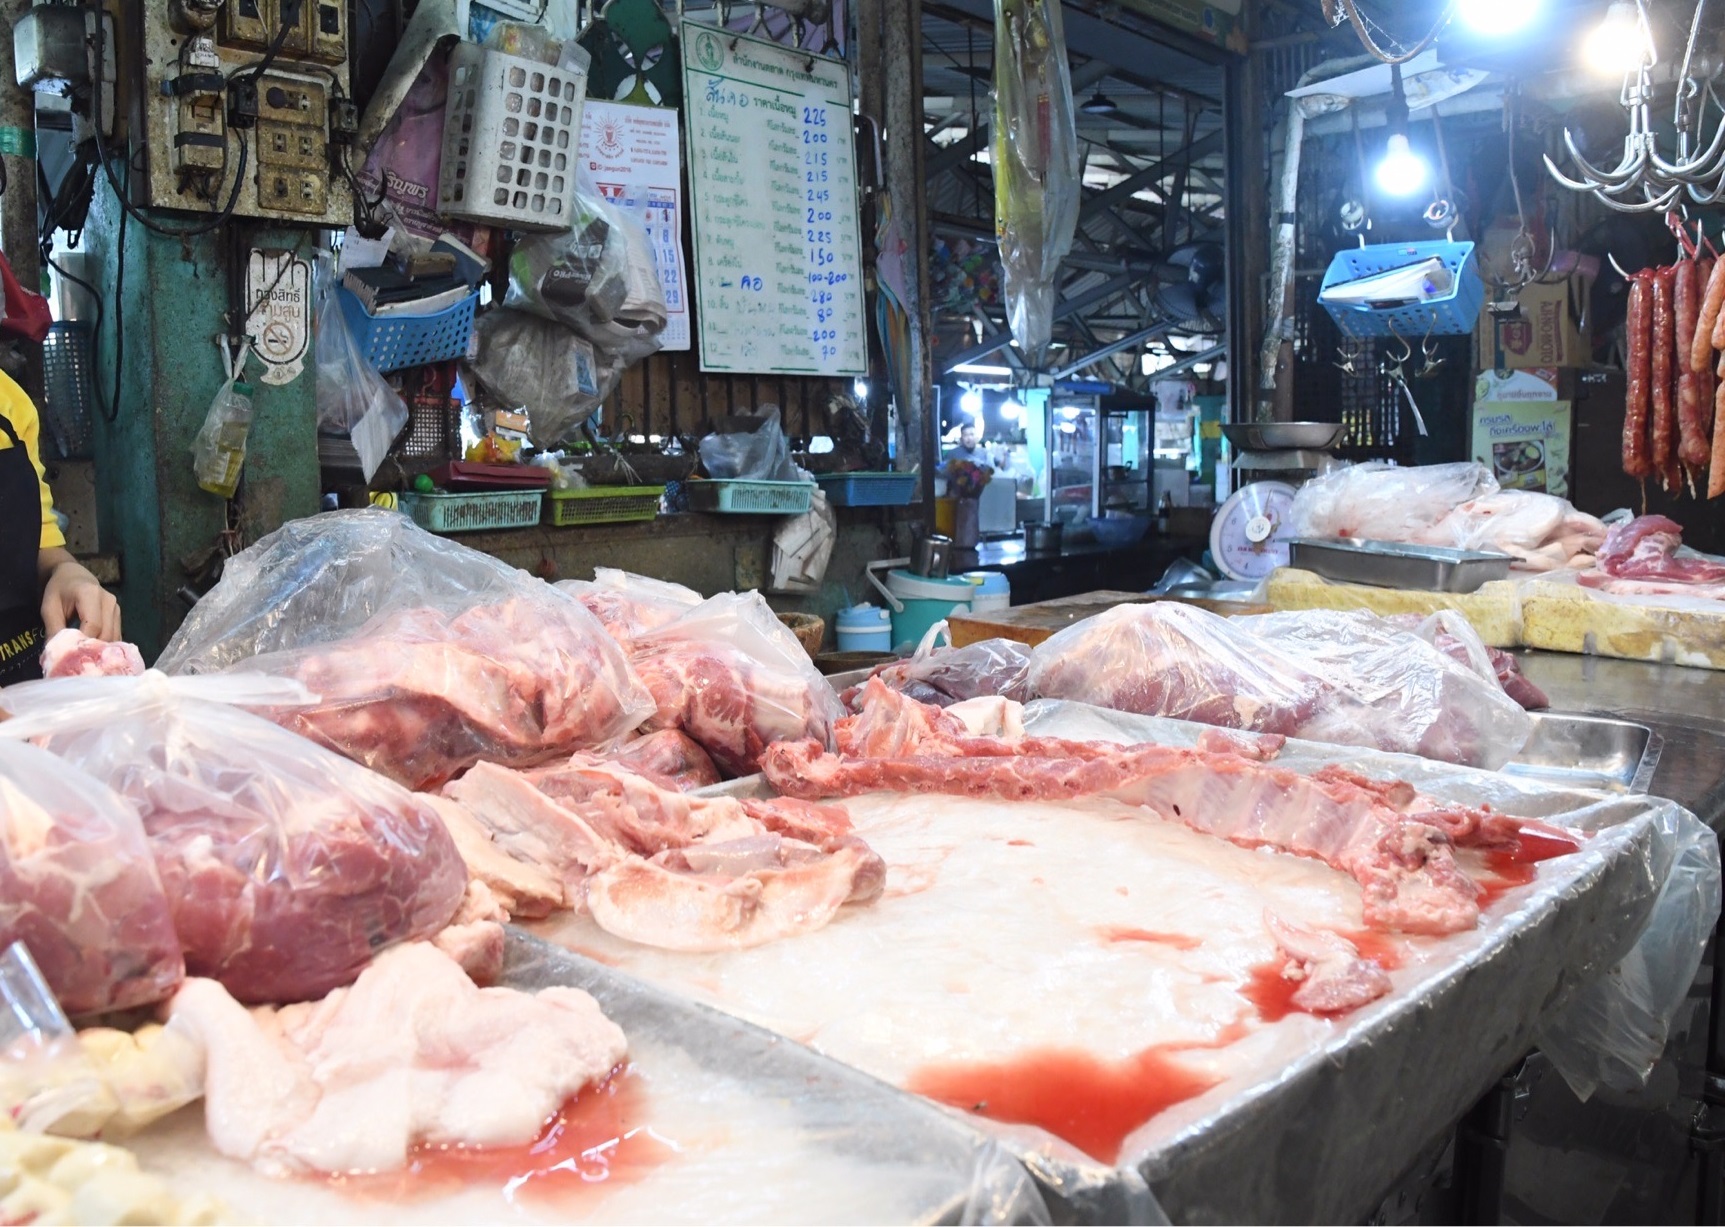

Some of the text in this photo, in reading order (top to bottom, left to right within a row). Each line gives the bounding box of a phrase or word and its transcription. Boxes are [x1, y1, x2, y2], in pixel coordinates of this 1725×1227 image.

[803, 107, 827, 126] 225
[803, 130, 827, 144] 200
[805, 151, 827, 166] 215
[807, 170, 828, 182] 215
[807, 189, 829, 203] 245
[807, 207, 832, 223] 200
[807, 229, 832, 244] 225
[663, 249, 675, 263] 15
[811, 248, 834, 266] 150
[664, 270, 677, 284] 22
[665, 290, 679, 304] 29
[811, 289, 833, 304] 280
[817, 308, 833, 323] 80
[813, 330, 836, 342] 200
[822, 345, 837, 360] 70
